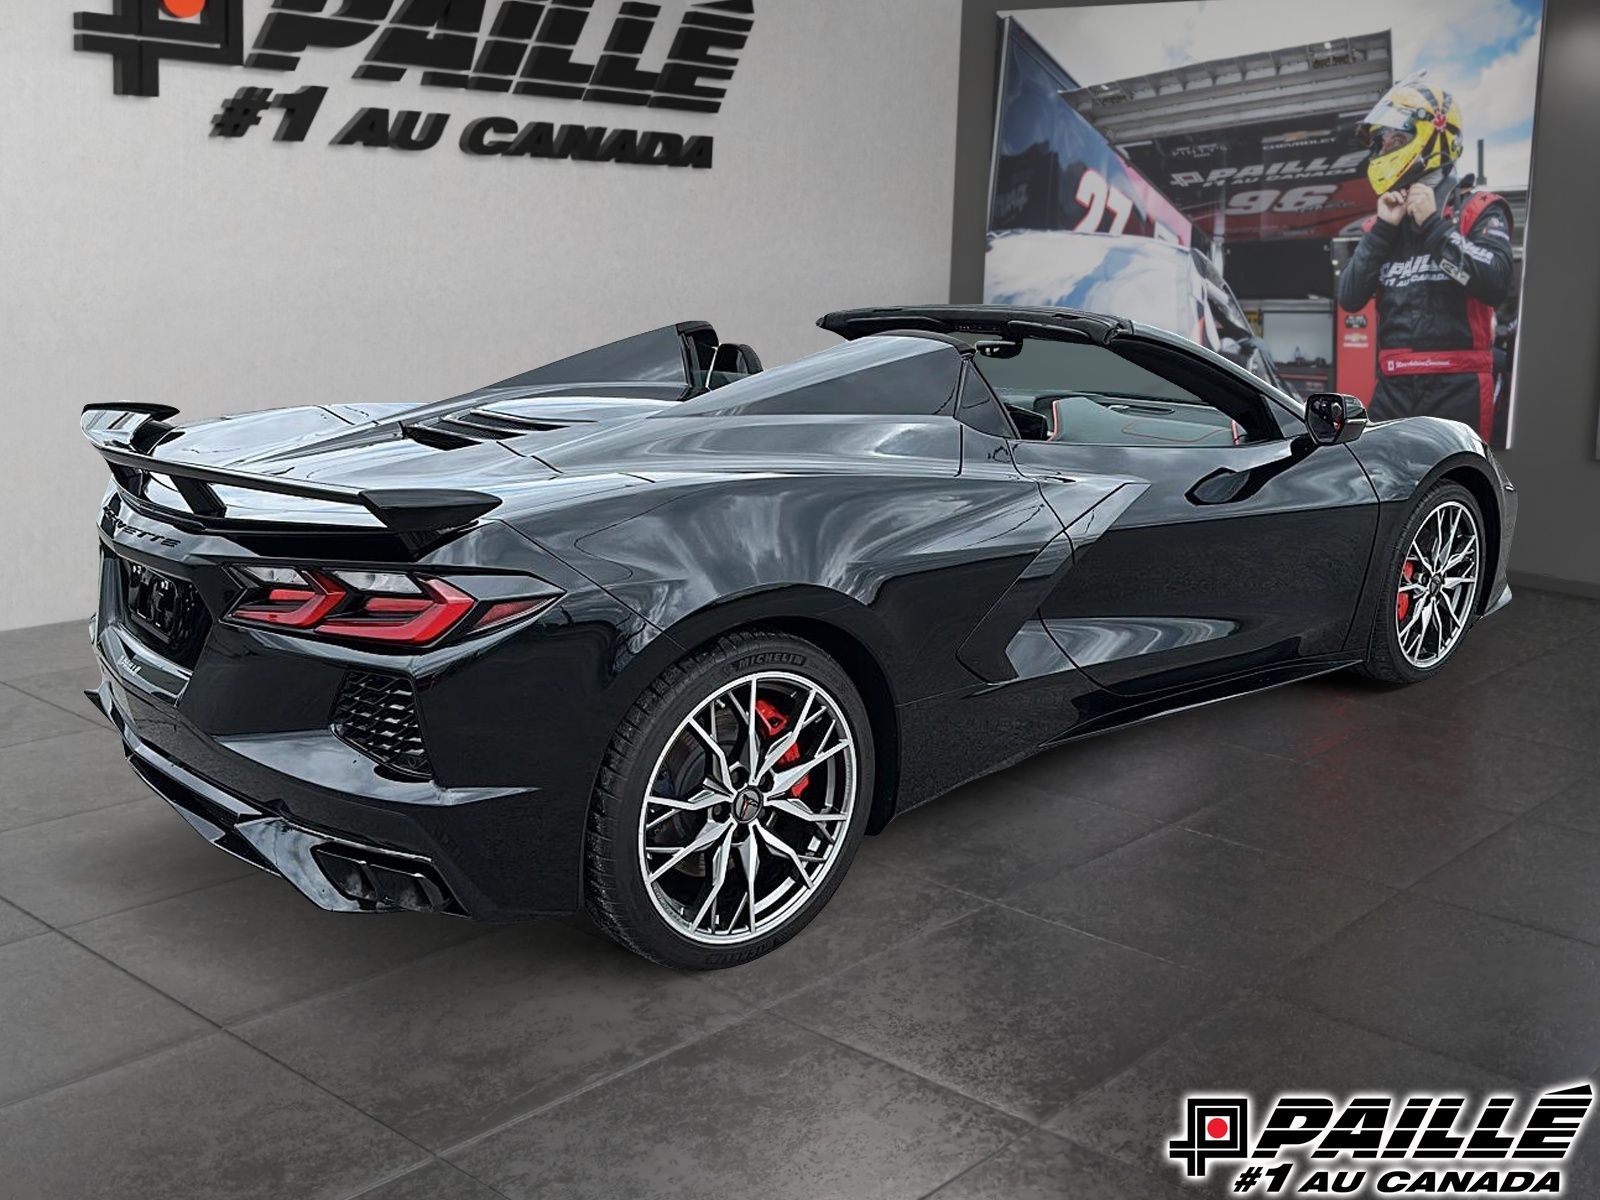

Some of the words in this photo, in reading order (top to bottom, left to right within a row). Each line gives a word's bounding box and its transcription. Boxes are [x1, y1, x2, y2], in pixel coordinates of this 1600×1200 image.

[208, 85, 329, 142] #1
[328, 107, 451, 151] AU
[459, 116, 714, 169] CANADA
[1265, 168, 1356, 181] CANADA
[1225, 184, 1338, 215] 96
[739, 652, 804, 668] MICHELIN
